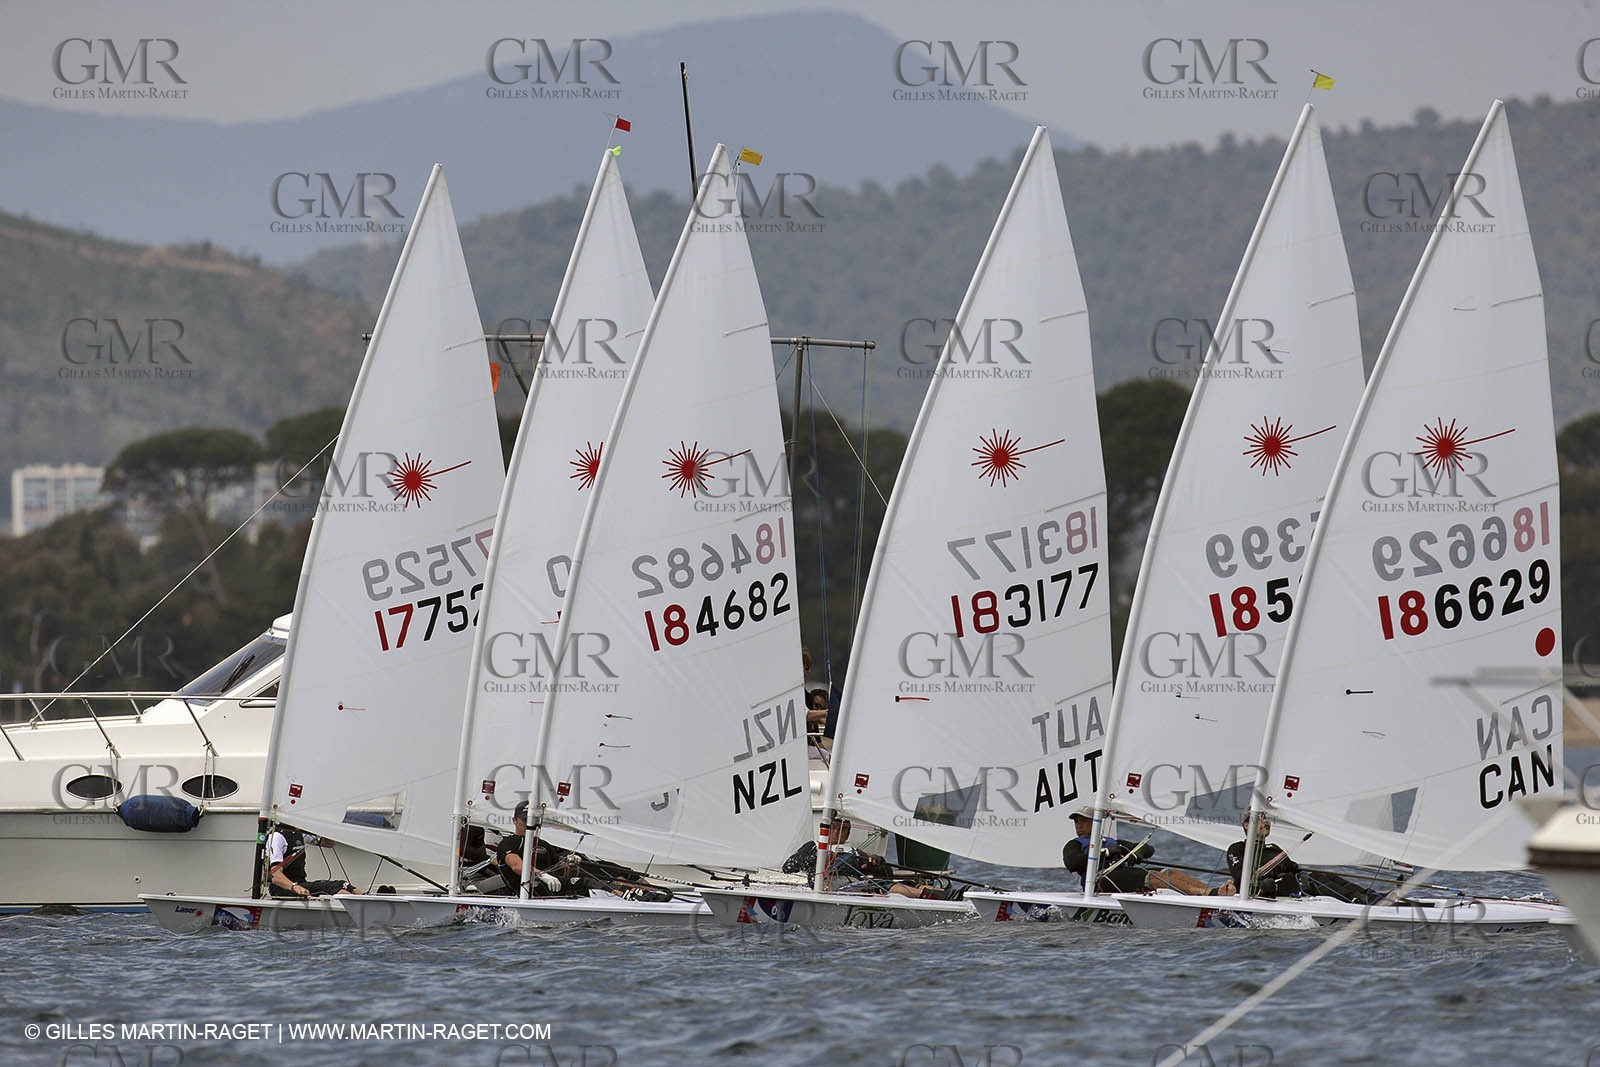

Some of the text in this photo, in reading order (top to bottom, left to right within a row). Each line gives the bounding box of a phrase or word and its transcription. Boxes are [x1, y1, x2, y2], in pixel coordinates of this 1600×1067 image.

[644, 572, 790, 651] 184682
[951, 562, 1099, 638] 183177
[1209, 577, 1303, 637] 185
[1378, 559, 1550, 640] 186629
[733, 758, 802, 814] NZL
[1034, 749, 1103, 813] AUT
[1479, 744, 1554, 809] CAN
[174, 905, 197, 914] Laser
